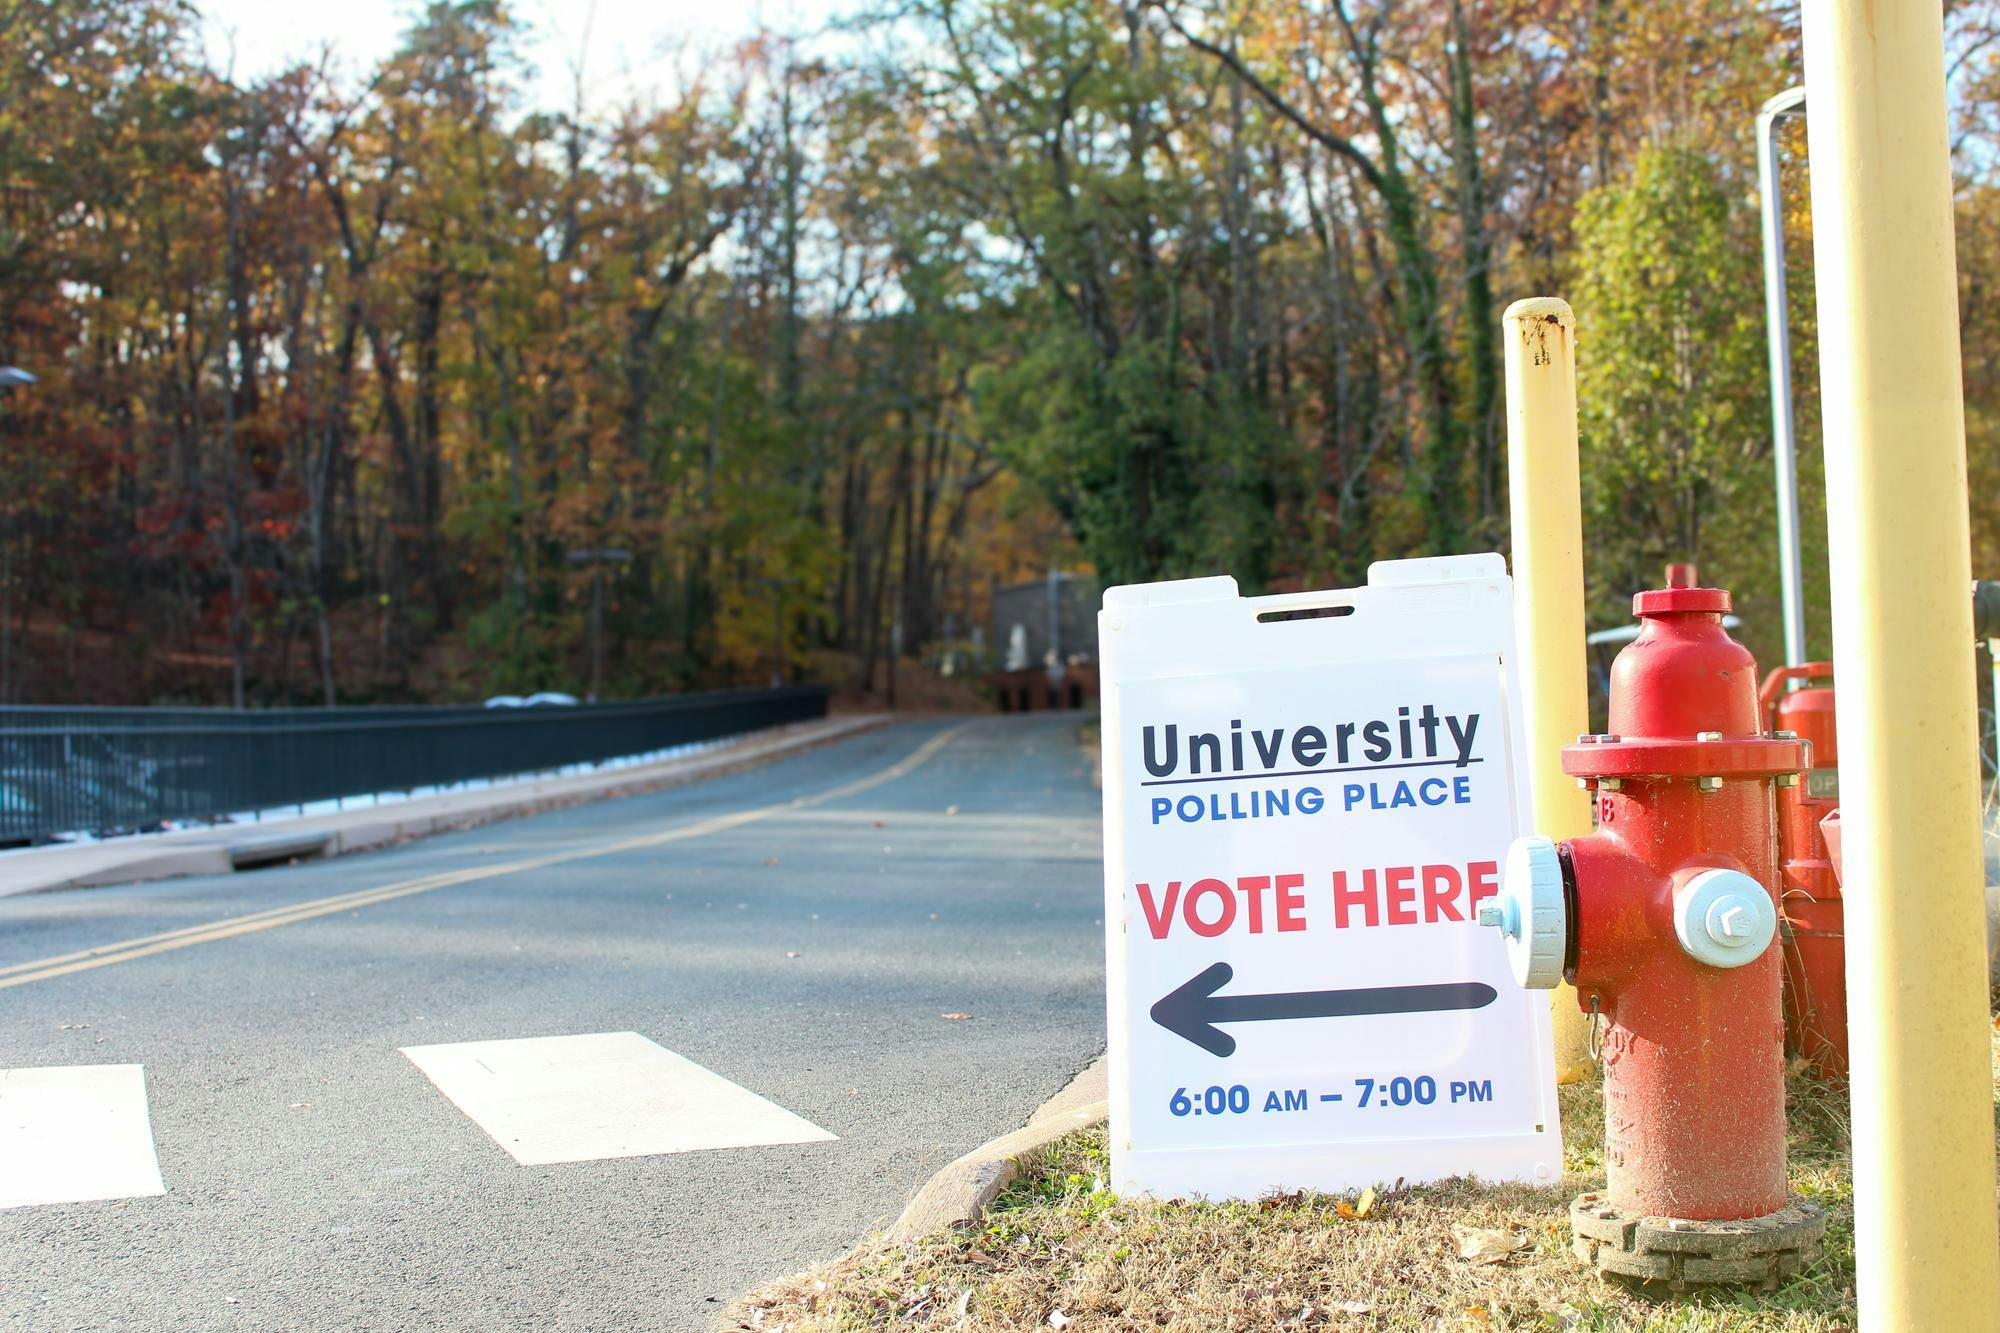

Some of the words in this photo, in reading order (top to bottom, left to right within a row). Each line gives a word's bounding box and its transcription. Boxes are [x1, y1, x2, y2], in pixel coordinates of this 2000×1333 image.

[1142, 704, 1482, 778] University
[1151, 786, 1325, 825] POLLING
[1343, 775, 1472, 812] PLACE
[1135, 873, 1307, 940] VOTE
[1169, 1084, 1250, 1118] 6:00
[1262, 1088, 1309, 1113] AM
[1354, 1074, 1437, 1109] 7:00
[1449, 1079, 1493, 1104] PM
